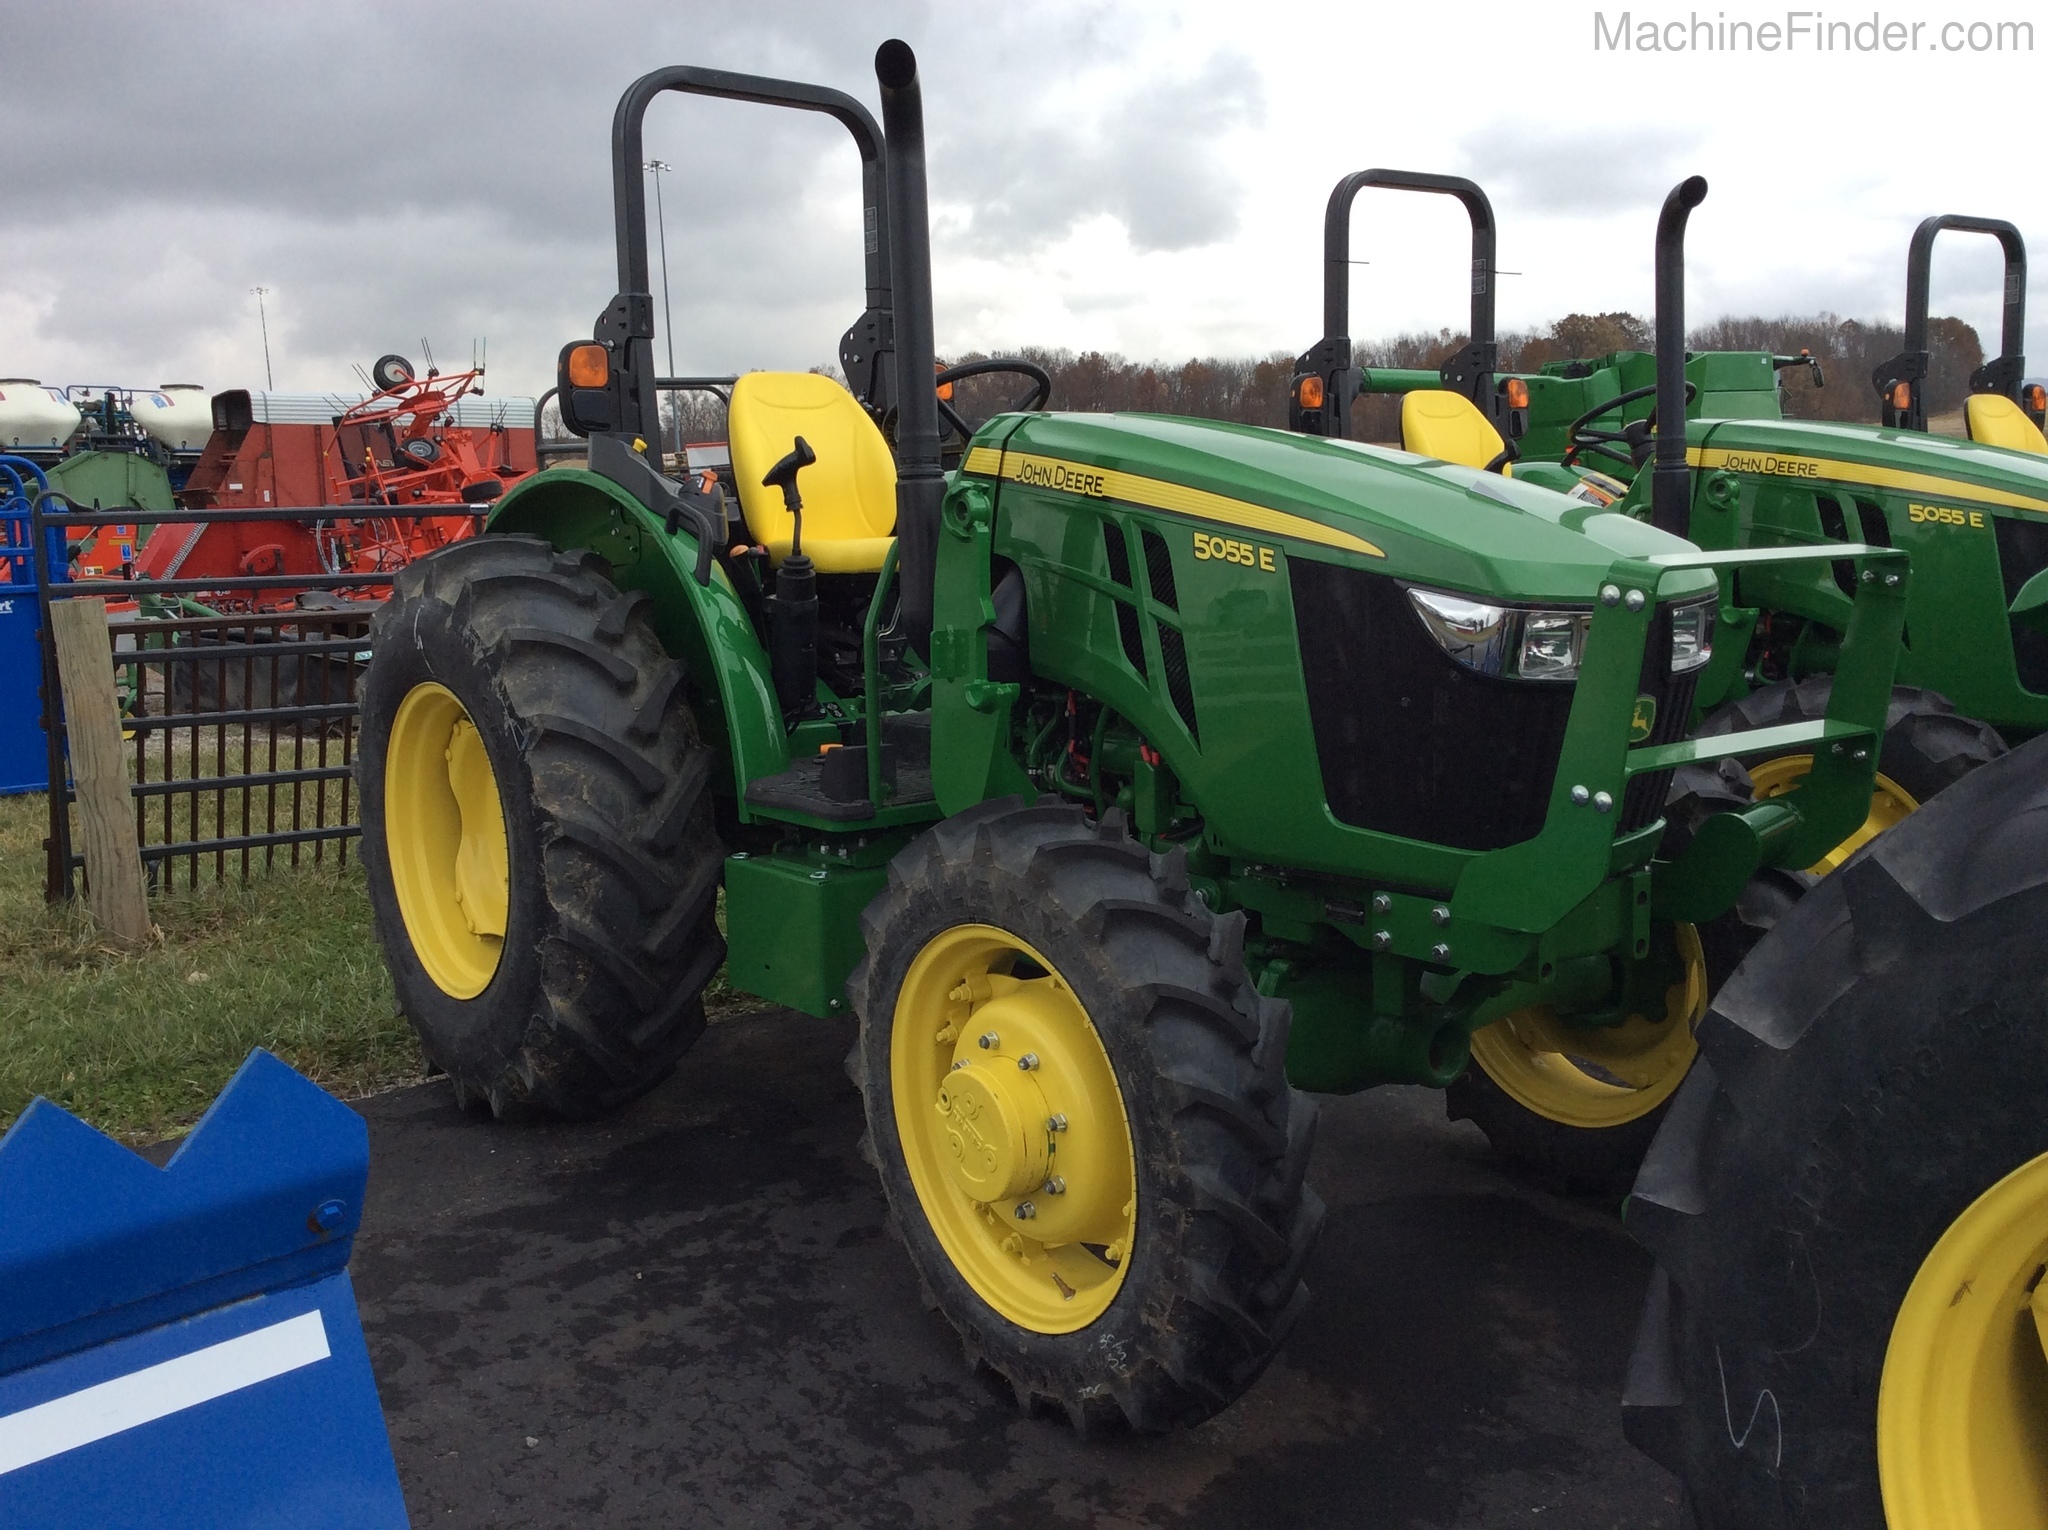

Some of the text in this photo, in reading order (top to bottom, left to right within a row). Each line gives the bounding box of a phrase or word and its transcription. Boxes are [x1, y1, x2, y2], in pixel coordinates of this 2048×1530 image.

[1016, 459, 1105, 494] JOHN DEERE
[1722, 454, 1818, 476] JOHN DEERE
[1908, 503, 1984, 528] 5055 E
[1193, 532, 1276, 572] 5055 E
